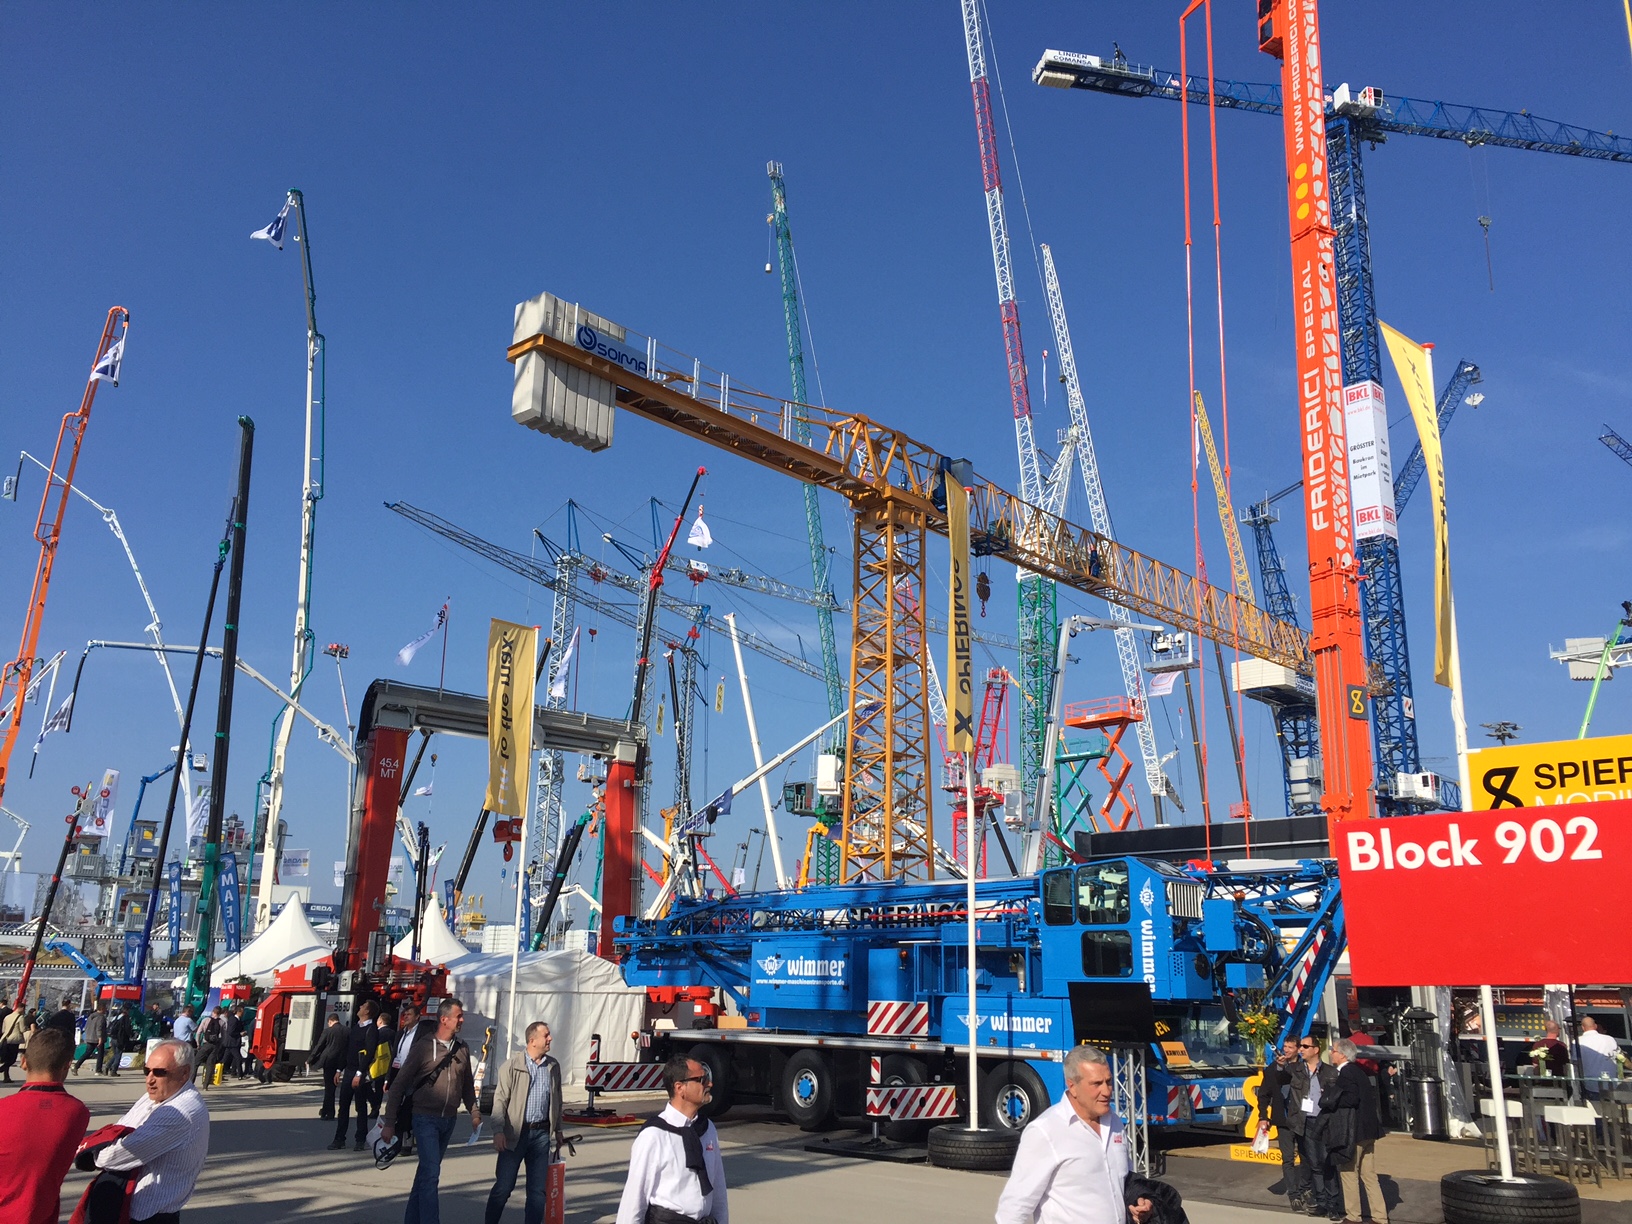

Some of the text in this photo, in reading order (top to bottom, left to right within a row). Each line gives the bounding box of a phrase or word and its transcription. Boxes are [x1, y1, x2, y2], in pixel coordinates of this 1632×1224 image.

[1053, 55, 1092, 66] COMANSA
[1058, 51, 1088, 60] LINDEN
[598, 342, 648, 374] SOIMA
[1302, 260, 1329, 531] FRIDERICI SPECIAL
[1349, 388, 1370, 402] BKL
[1350, 440, 1375, 452] GRÖSSTER
[1354, 470, 1376, 480] Mietpark
[1360, 510, 1380, 522] BKL
[1385, 512, 1396, 524] BKL
[380, 768, 396, 778] MT
[1347, 816, 1603, 871] Block 902
[222, 872, 236, 951] MAEDA
[788, 956, 845, 976] wimmer
[990, 1012, 1052, 1034] wimmer
[1234, 1148, 1282, 1162] SPIERINGS
